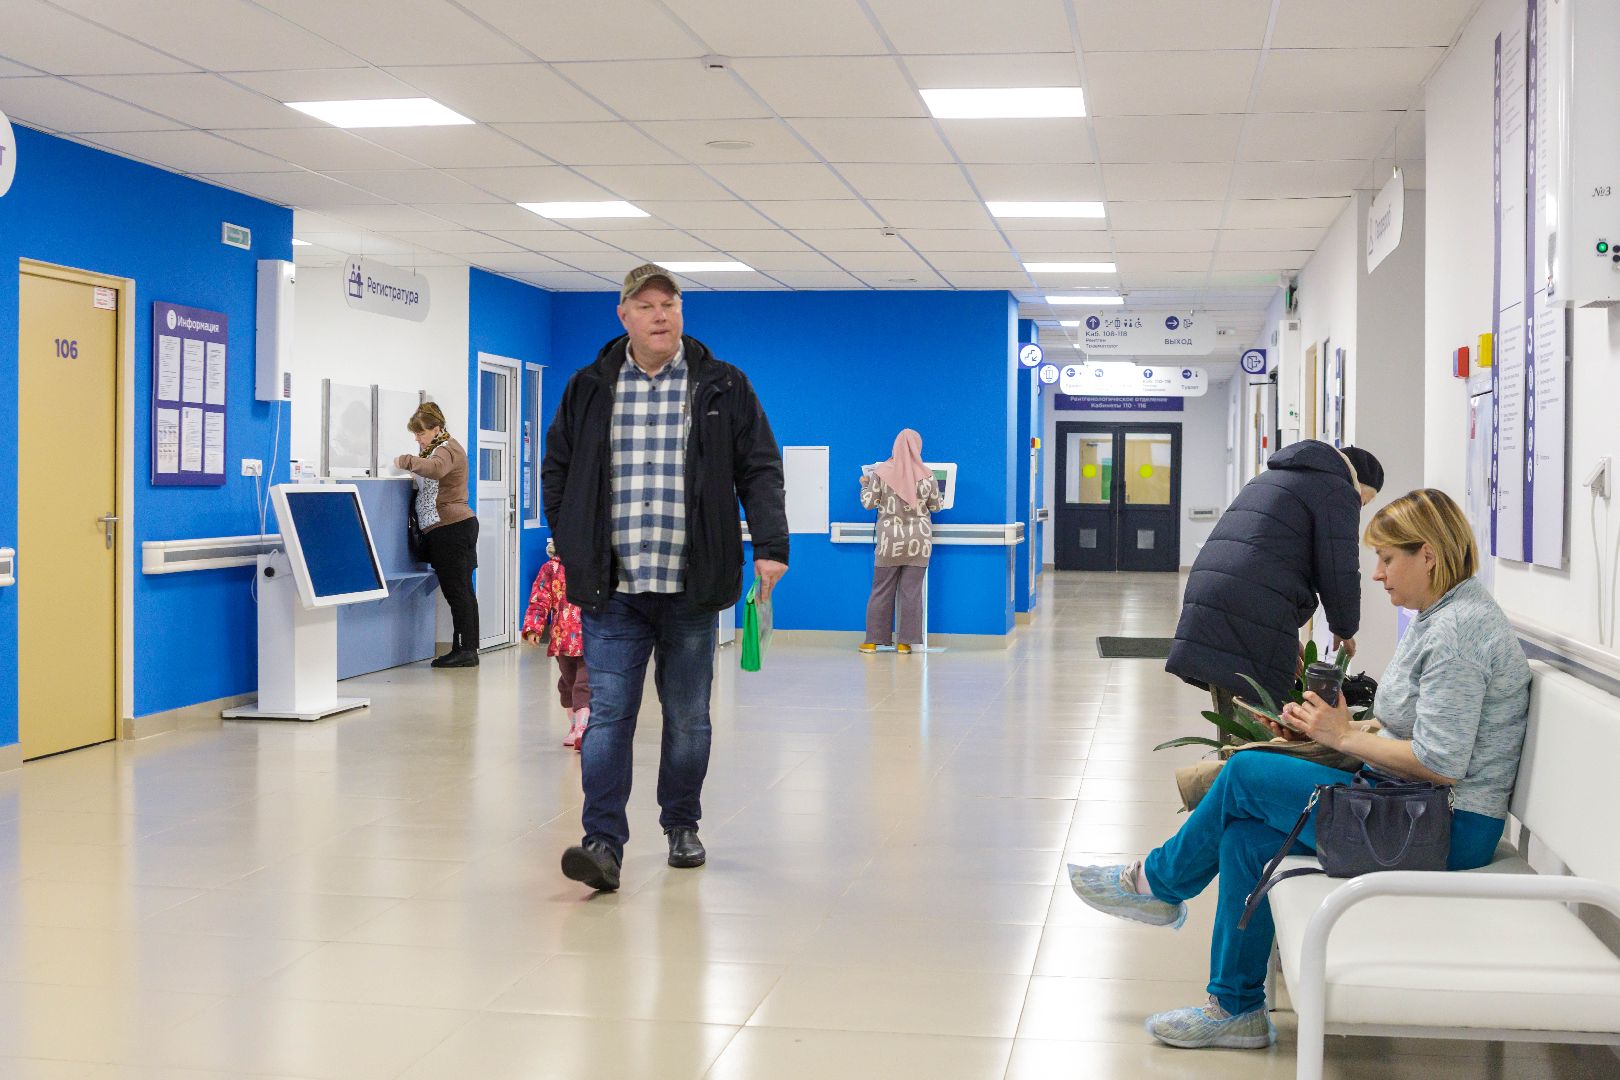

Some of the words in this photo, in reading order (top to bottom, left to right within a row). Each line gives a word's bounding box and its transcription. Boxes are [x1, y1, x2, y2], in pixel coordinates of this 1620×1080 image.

[1495, 53, 1500, 88] 2
[367, 276, 419, 305] Регистратура
[177, 315, 220, 334] Информация
[1527, 317, 1534, 354] 3
[55, 338, 79, 360] 106
[1164, 338, 1193, 346] ВЫХОД
